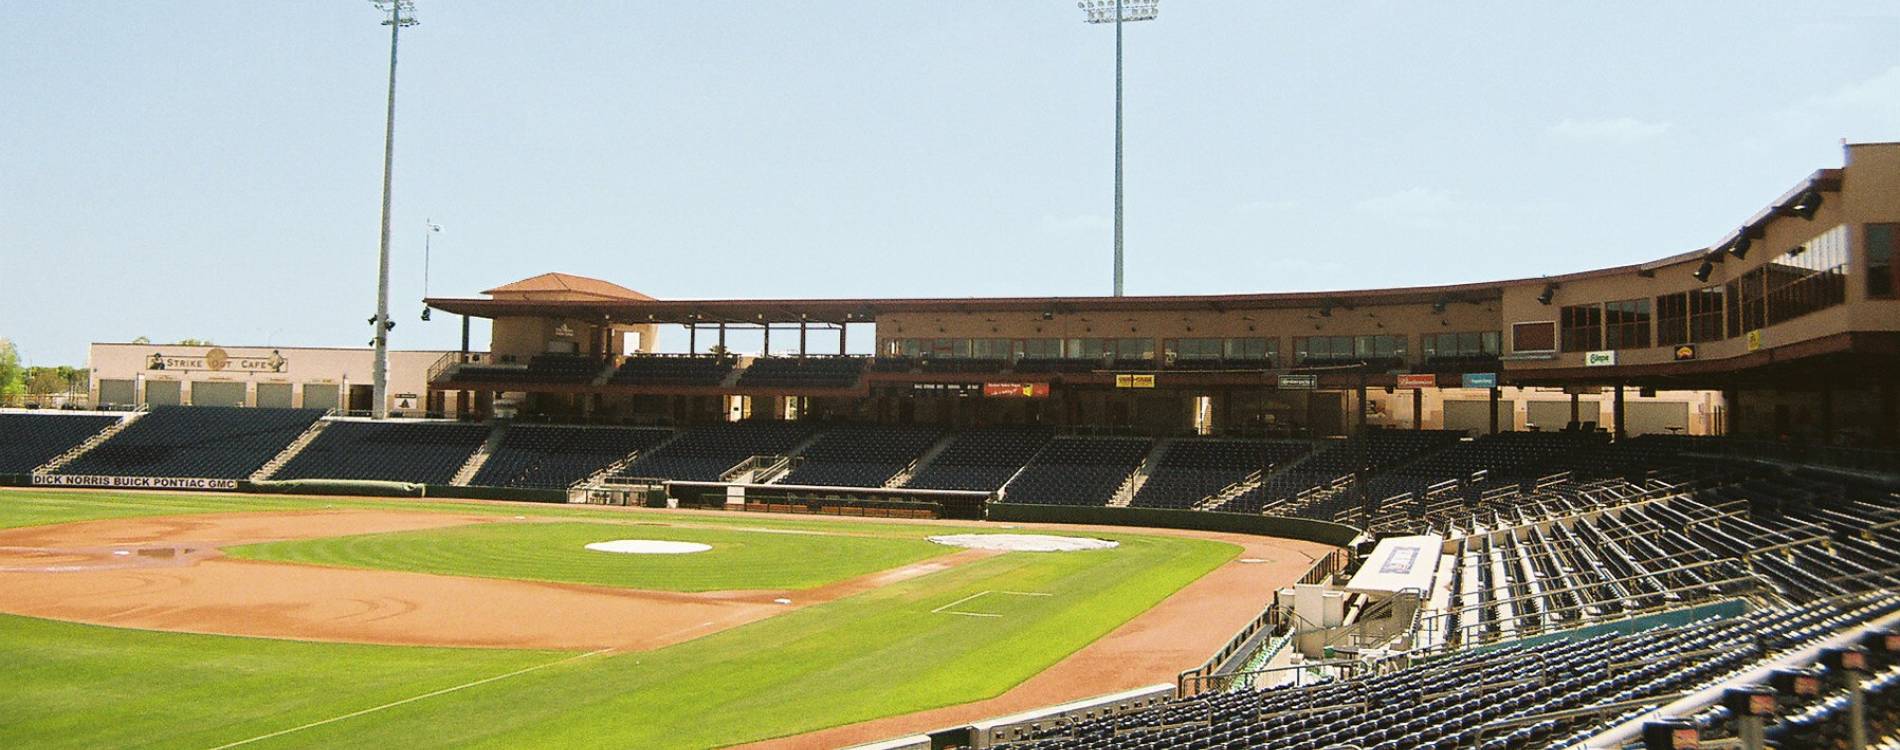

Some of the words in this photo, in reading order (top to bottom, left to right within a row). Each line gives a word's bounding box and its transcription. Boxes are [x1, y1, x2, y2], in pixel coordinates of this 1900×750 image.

[167, 359, 203, 368] STRIKE
[212, 360, 232, 369] OUT
[241, 360, 266, 369] CAFE
[34, 475, 62, 485] DICK
[66, 476, 110, 485] NORRIS
[114, 477, 149, 486] BUICK
[154, 478, 205, 487] PONTIAC
[208, 480, 234, 488] GMC
